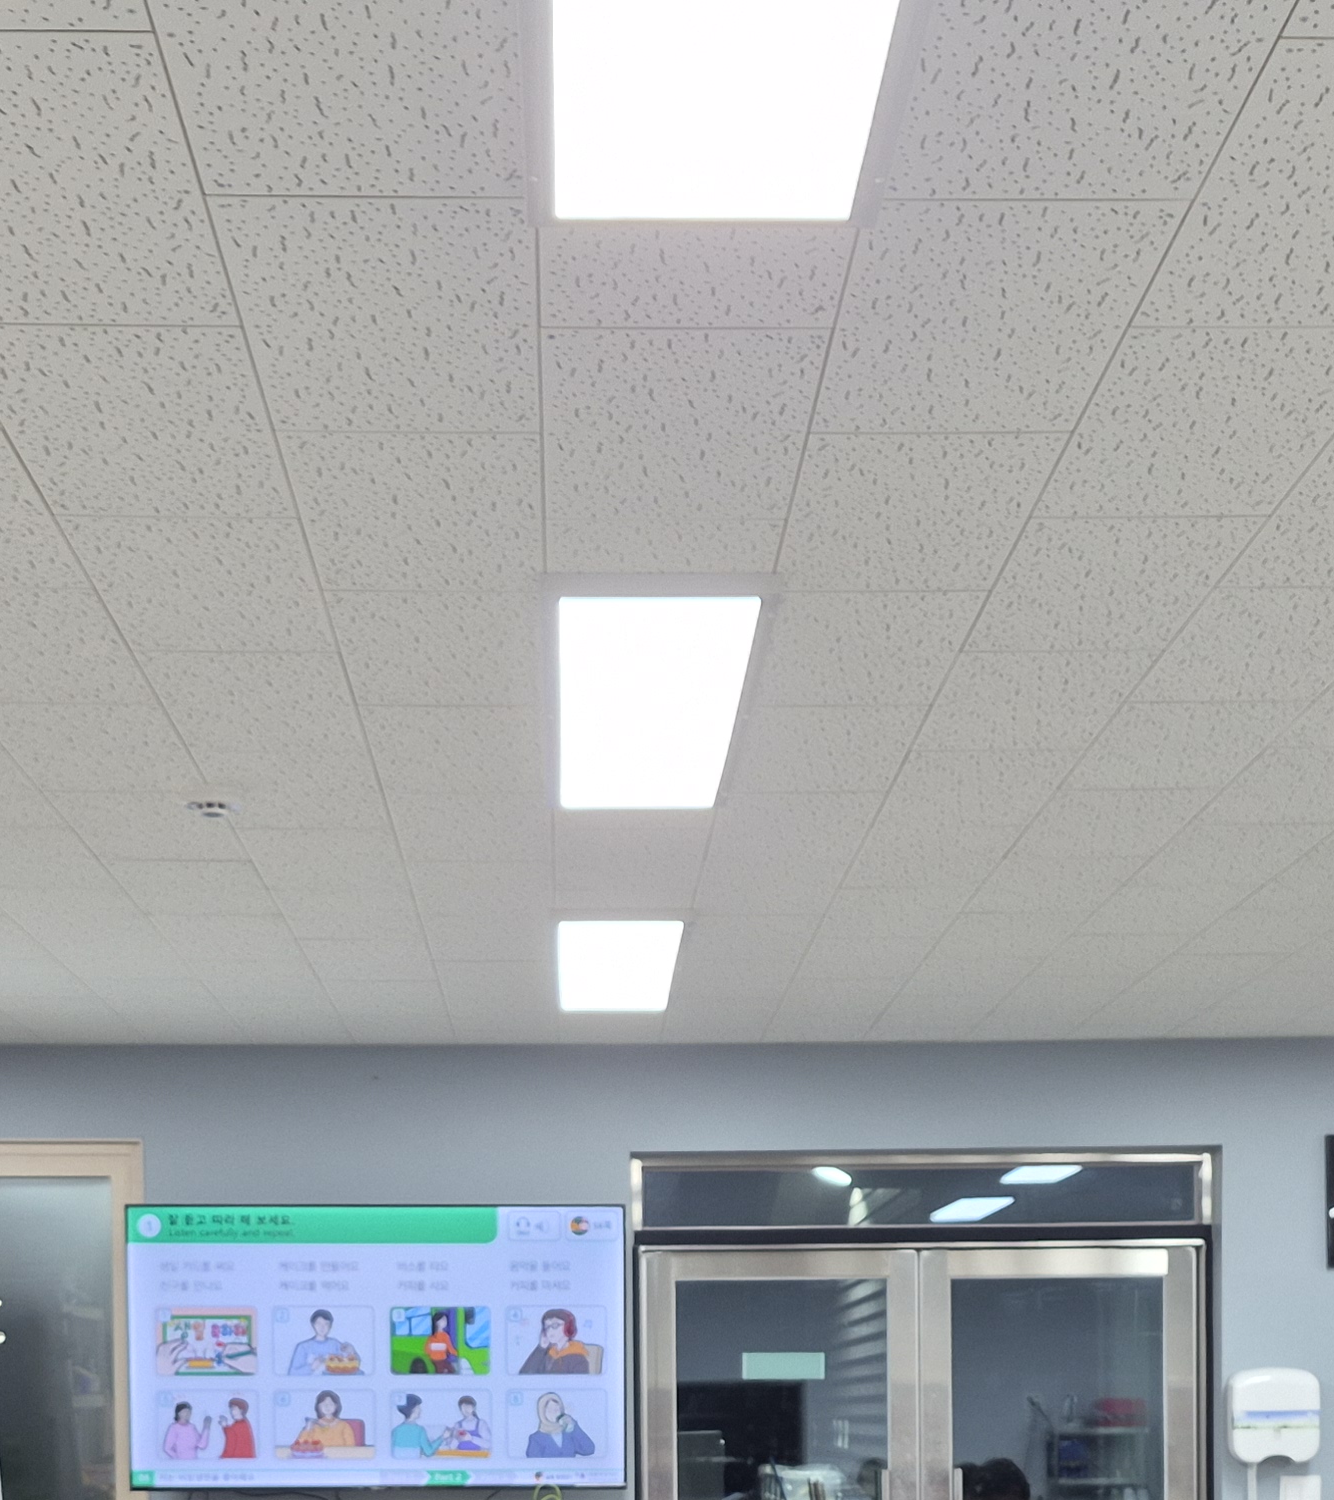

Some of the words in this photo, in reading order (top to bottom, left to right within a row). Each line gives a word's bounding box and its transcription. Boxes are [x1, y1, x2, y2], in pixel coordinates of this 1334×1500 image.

[212, 1214, 235, 1226] 따라
[169, 1228, 197, 1238] Listen
[199, 1228, 238, 1239] carefully
[242, 1229, 260, 1238] and
